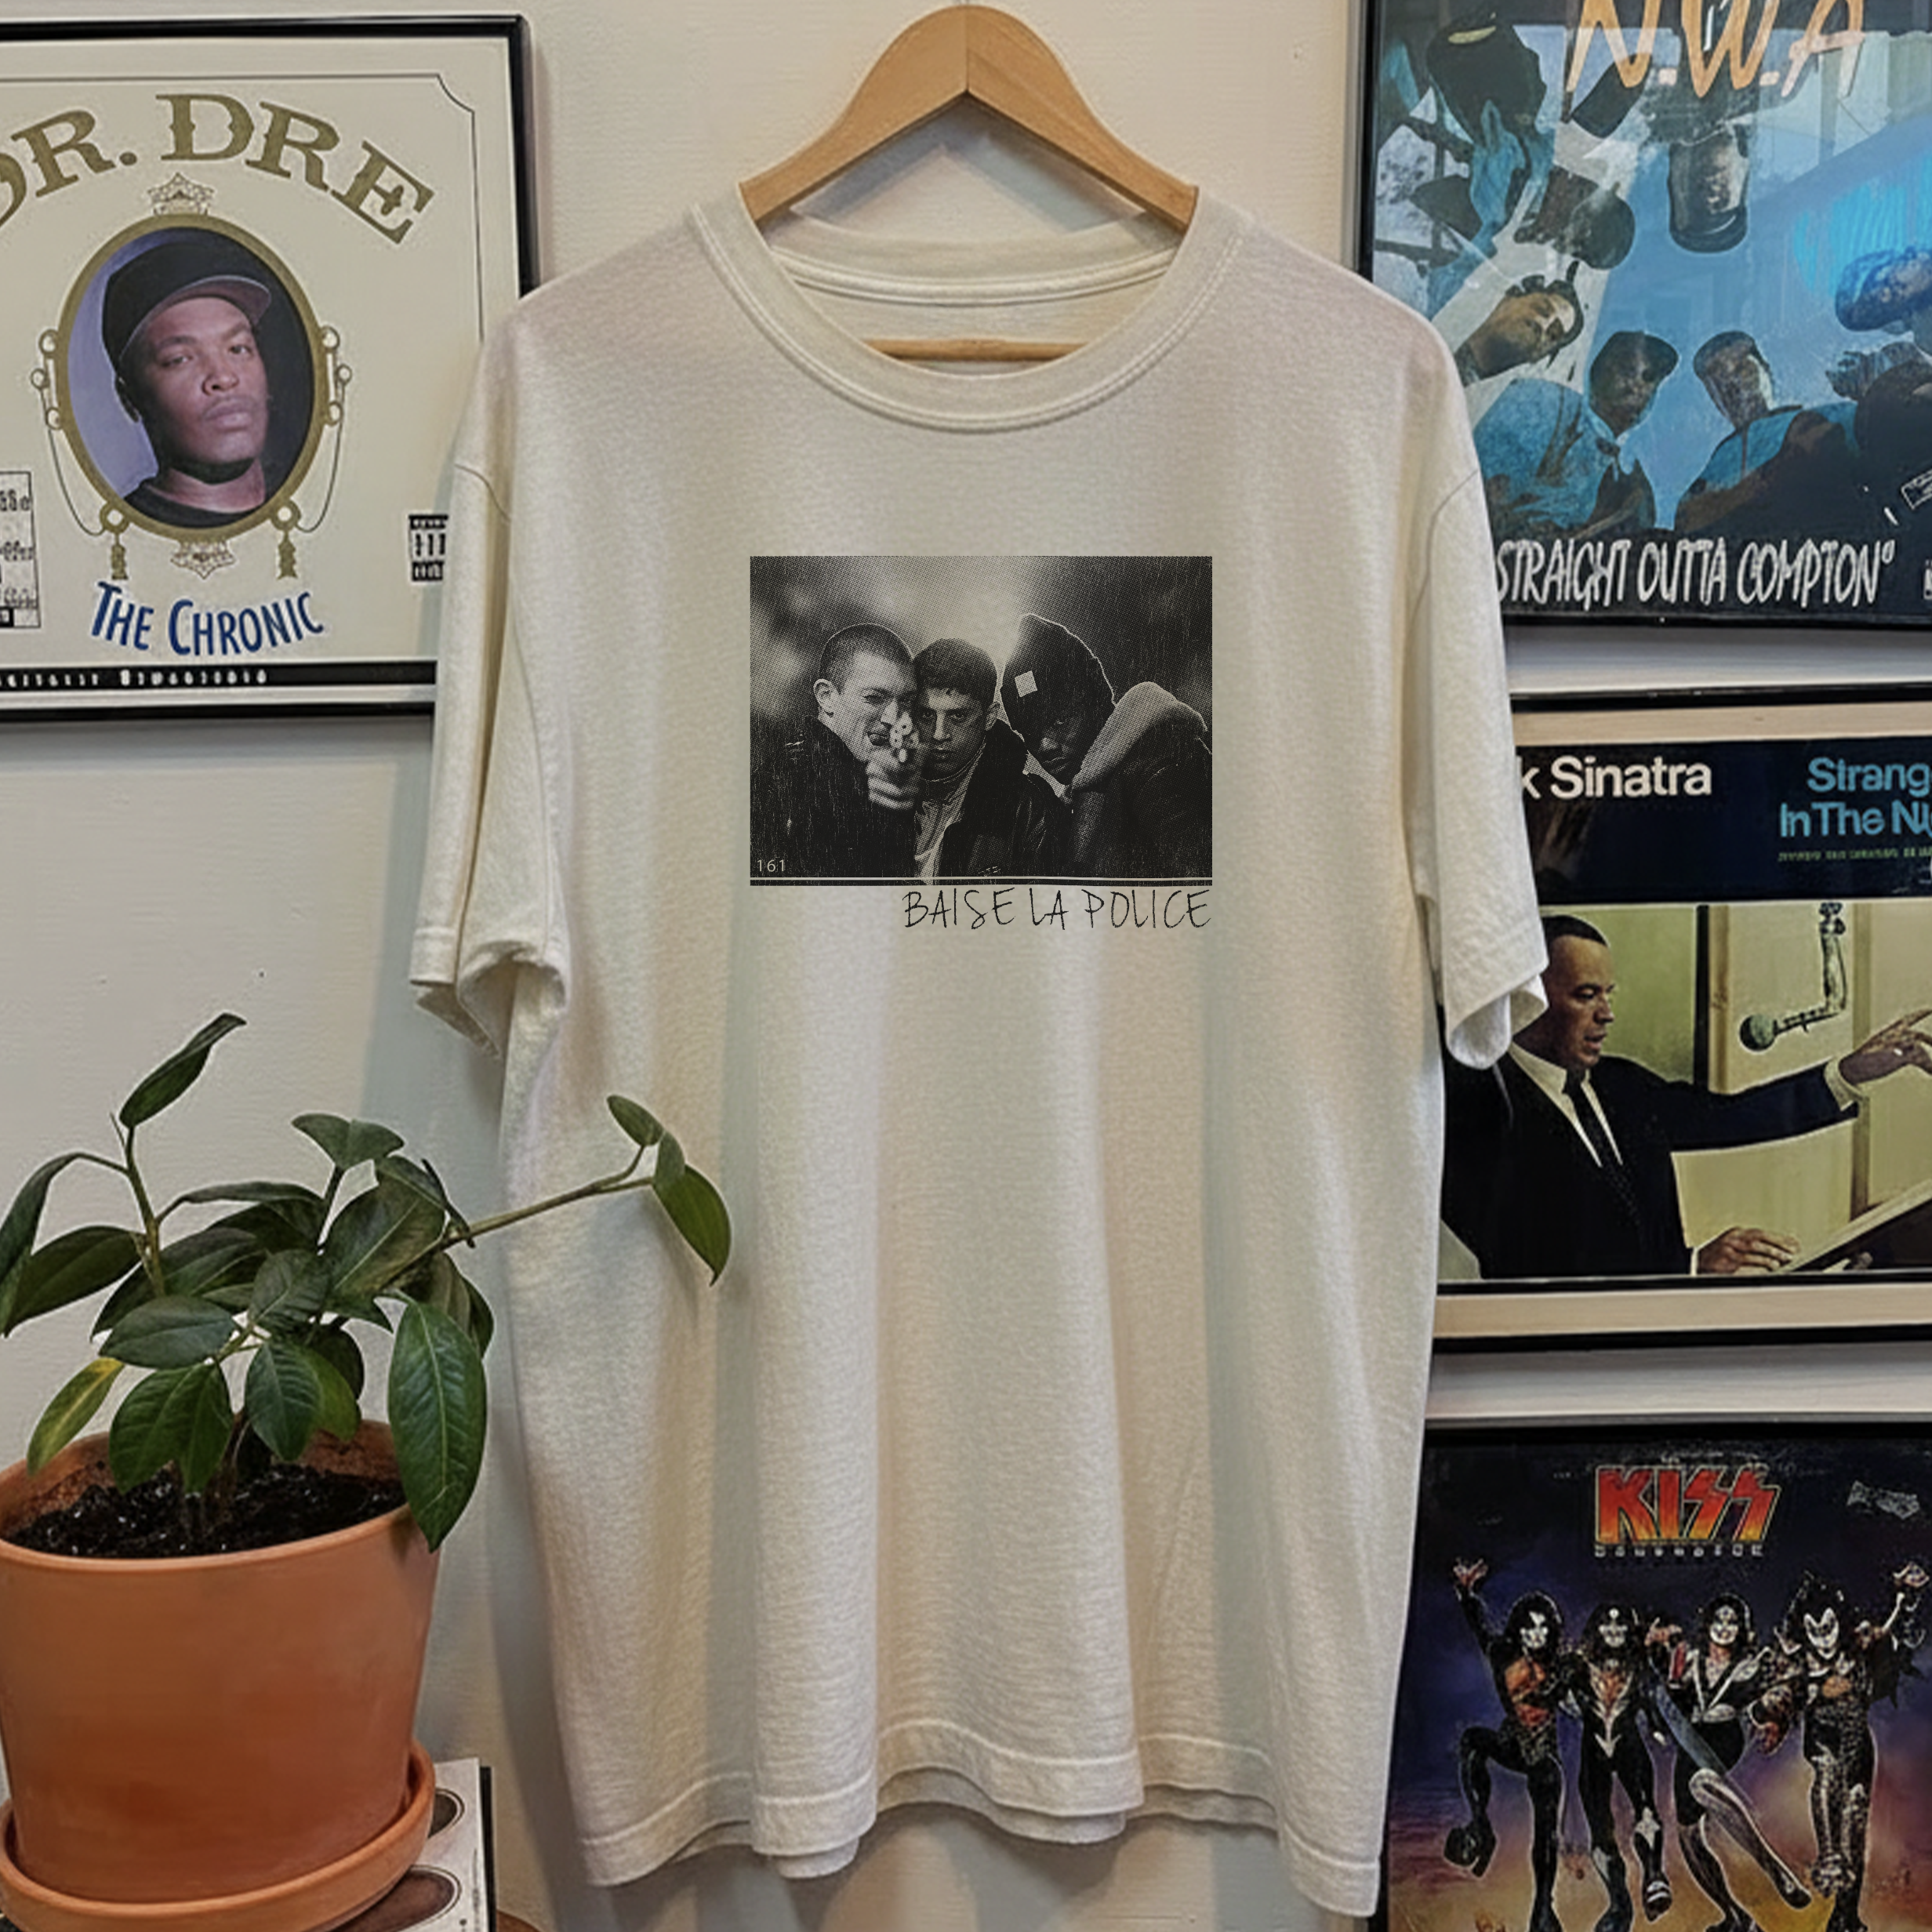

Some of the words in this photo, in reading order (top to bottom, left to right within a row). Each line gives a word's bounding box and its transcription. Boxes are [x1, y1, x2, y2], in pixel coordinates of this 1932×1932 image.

[155, 93, 435, 244] DRE
[1497, 538, 1632, 612] STRAIGHT
[1637, 537, 1727, 605] OUTTA
[1549, 755, 1712, 800] Sinatra
[1807, 756, 1932, 798] Strang
[1780, 801, 1811, 837] In
[1810, 801, 1885, 836] The
[757, 859, 784, 873] 161
[902, 888, 1017, 930] BAISE
[1029, 888, 1070, 931] LA
[1080, 888, 1212, 929] POLICE
[1594, 1462, 1783, 1543] KISS
